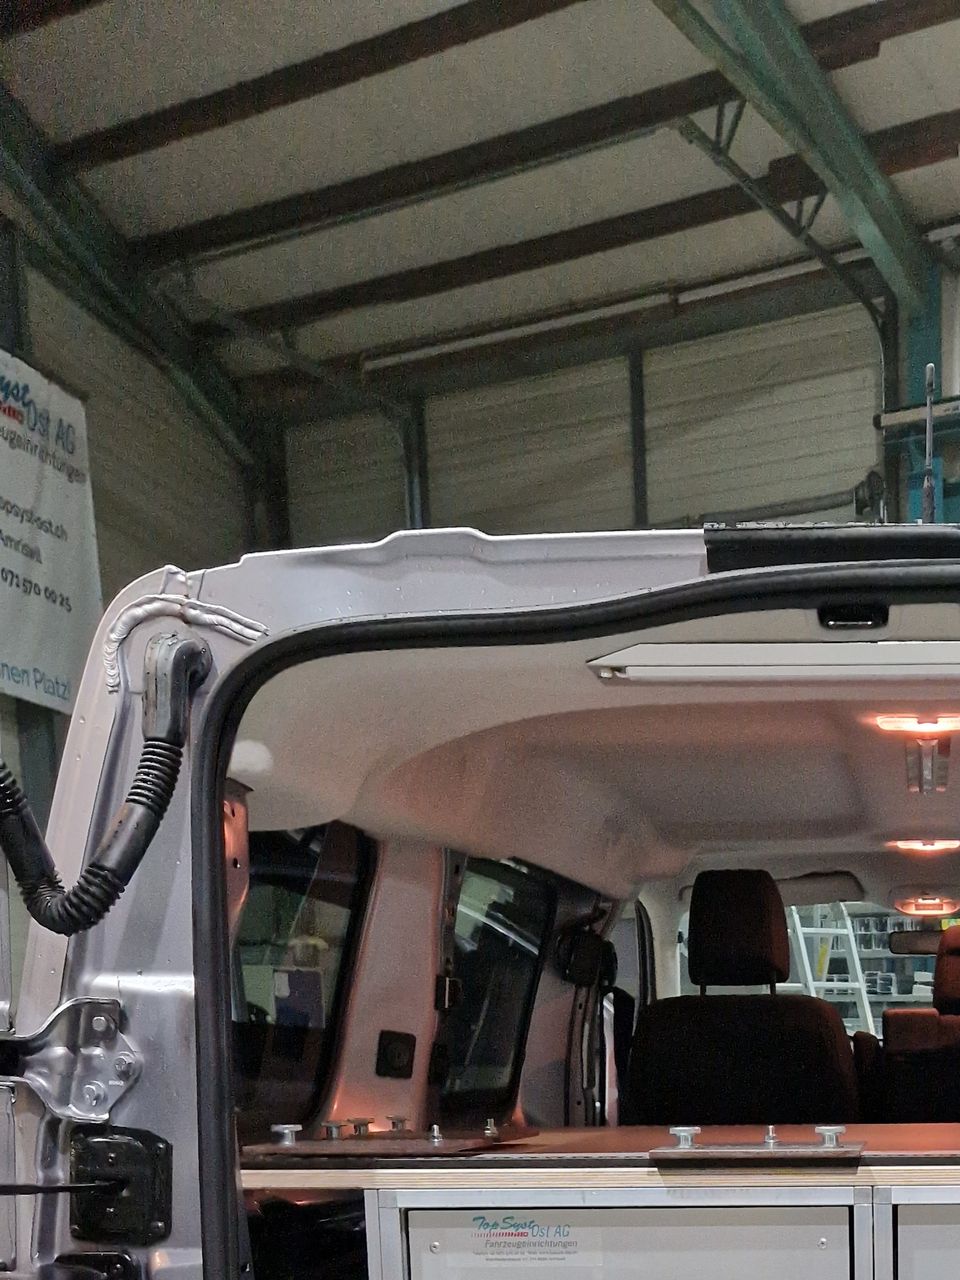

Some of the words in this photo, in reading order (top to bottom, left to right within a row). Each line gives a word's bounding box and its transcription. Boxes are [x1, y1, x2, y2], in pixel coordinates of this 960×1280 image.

[56, 418, 76, 454] AG
[553, 1224, 571, 1237] AG
[484, 1239, 578, 1249] Fahrzeugeinrichtungen
